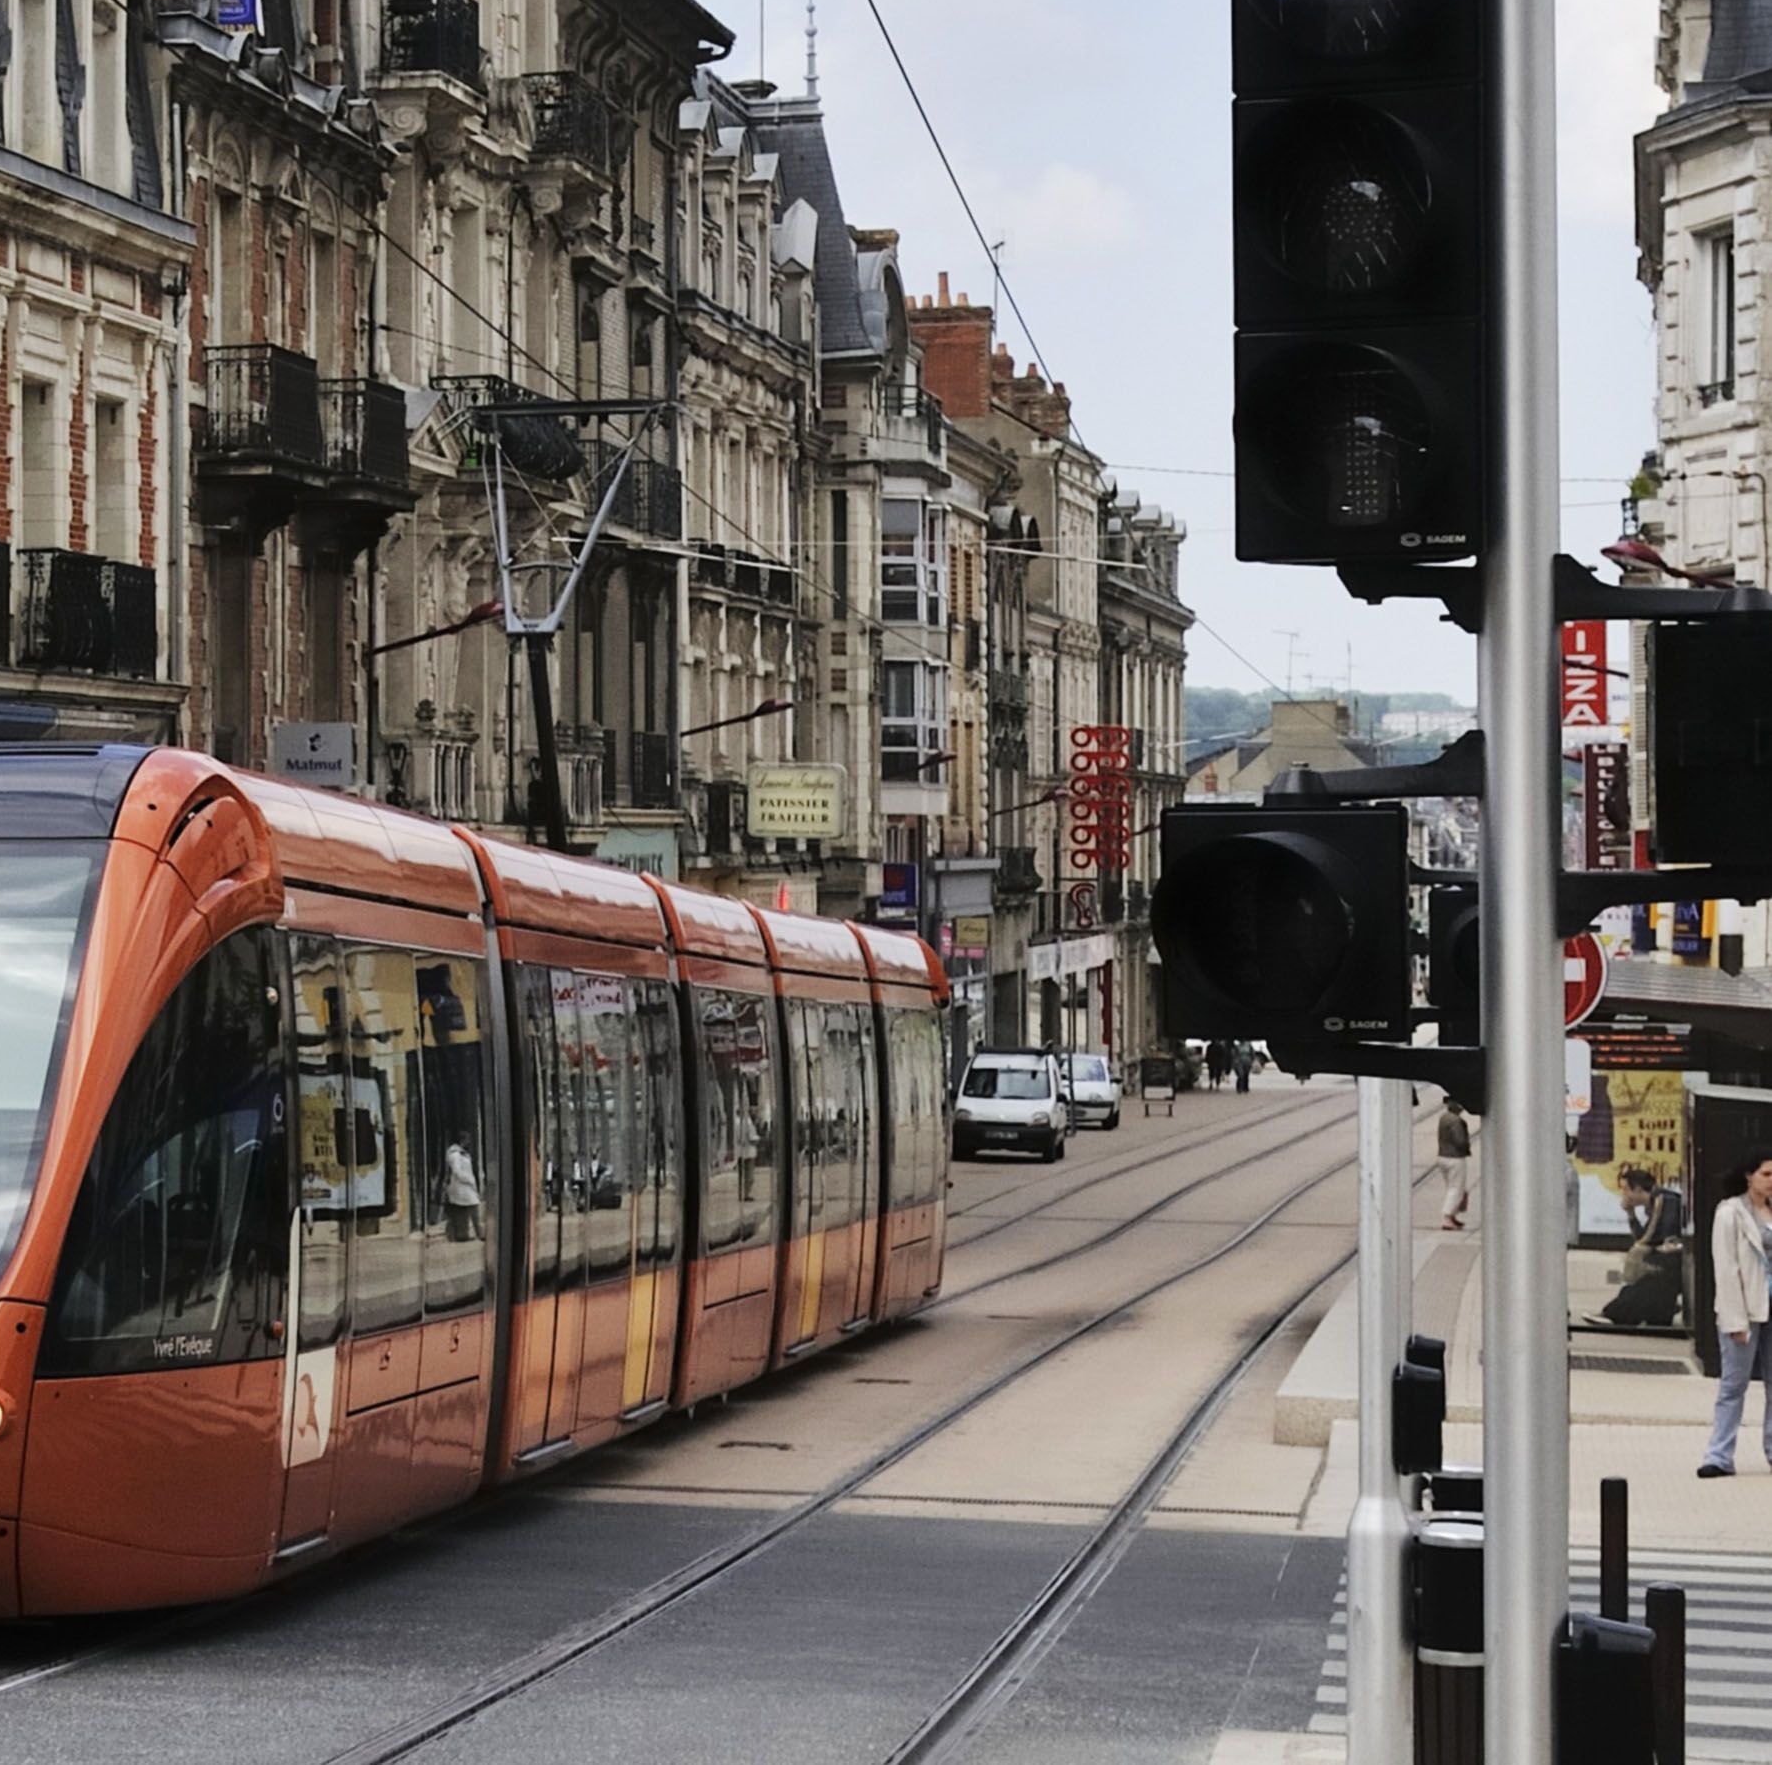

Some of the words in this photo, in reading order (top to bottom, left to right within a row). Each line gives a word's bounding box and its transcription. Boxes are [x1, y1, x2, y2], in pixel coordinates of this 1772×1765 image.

[1426, 534, 1466, 544] SAGEM
[1562, 621, 1601, 725] IZZA
[285, 759, 342, 772] Matmut
[759, 798, 829, 808] PATISSIER
[760, 812, 829, 823] TRAITEUR
[1349, 1020, 1389, 1030] SAGEM
